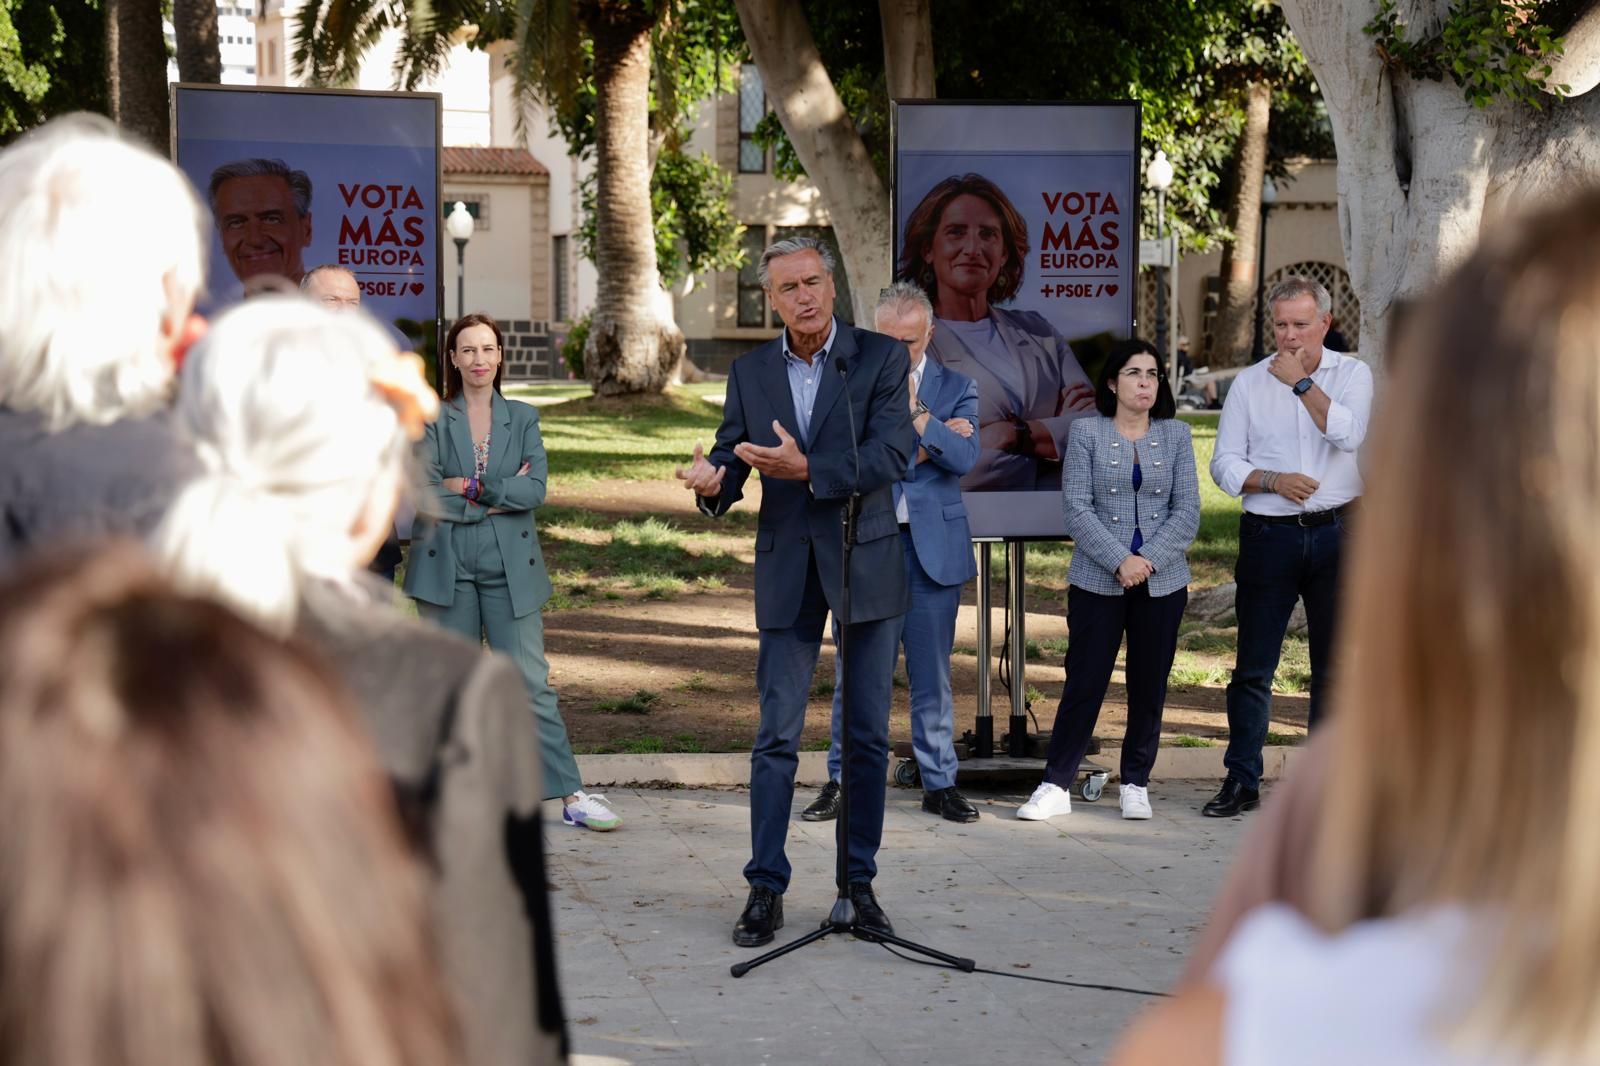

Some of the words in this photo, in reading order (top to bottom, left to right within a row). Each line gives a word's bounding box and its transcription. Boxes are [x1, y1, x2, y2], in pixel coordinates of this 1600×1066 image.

[337, 183, 424, 209] VOTA
[1041, 192, 1120, 215] VOTA
[338, 209, 425, 247] MÁS
[1040, 215, 1120, 251] MÁS
[338, 248, 424, 266] EUROPA
[1040, 253, 1119, 269] EUROPA
